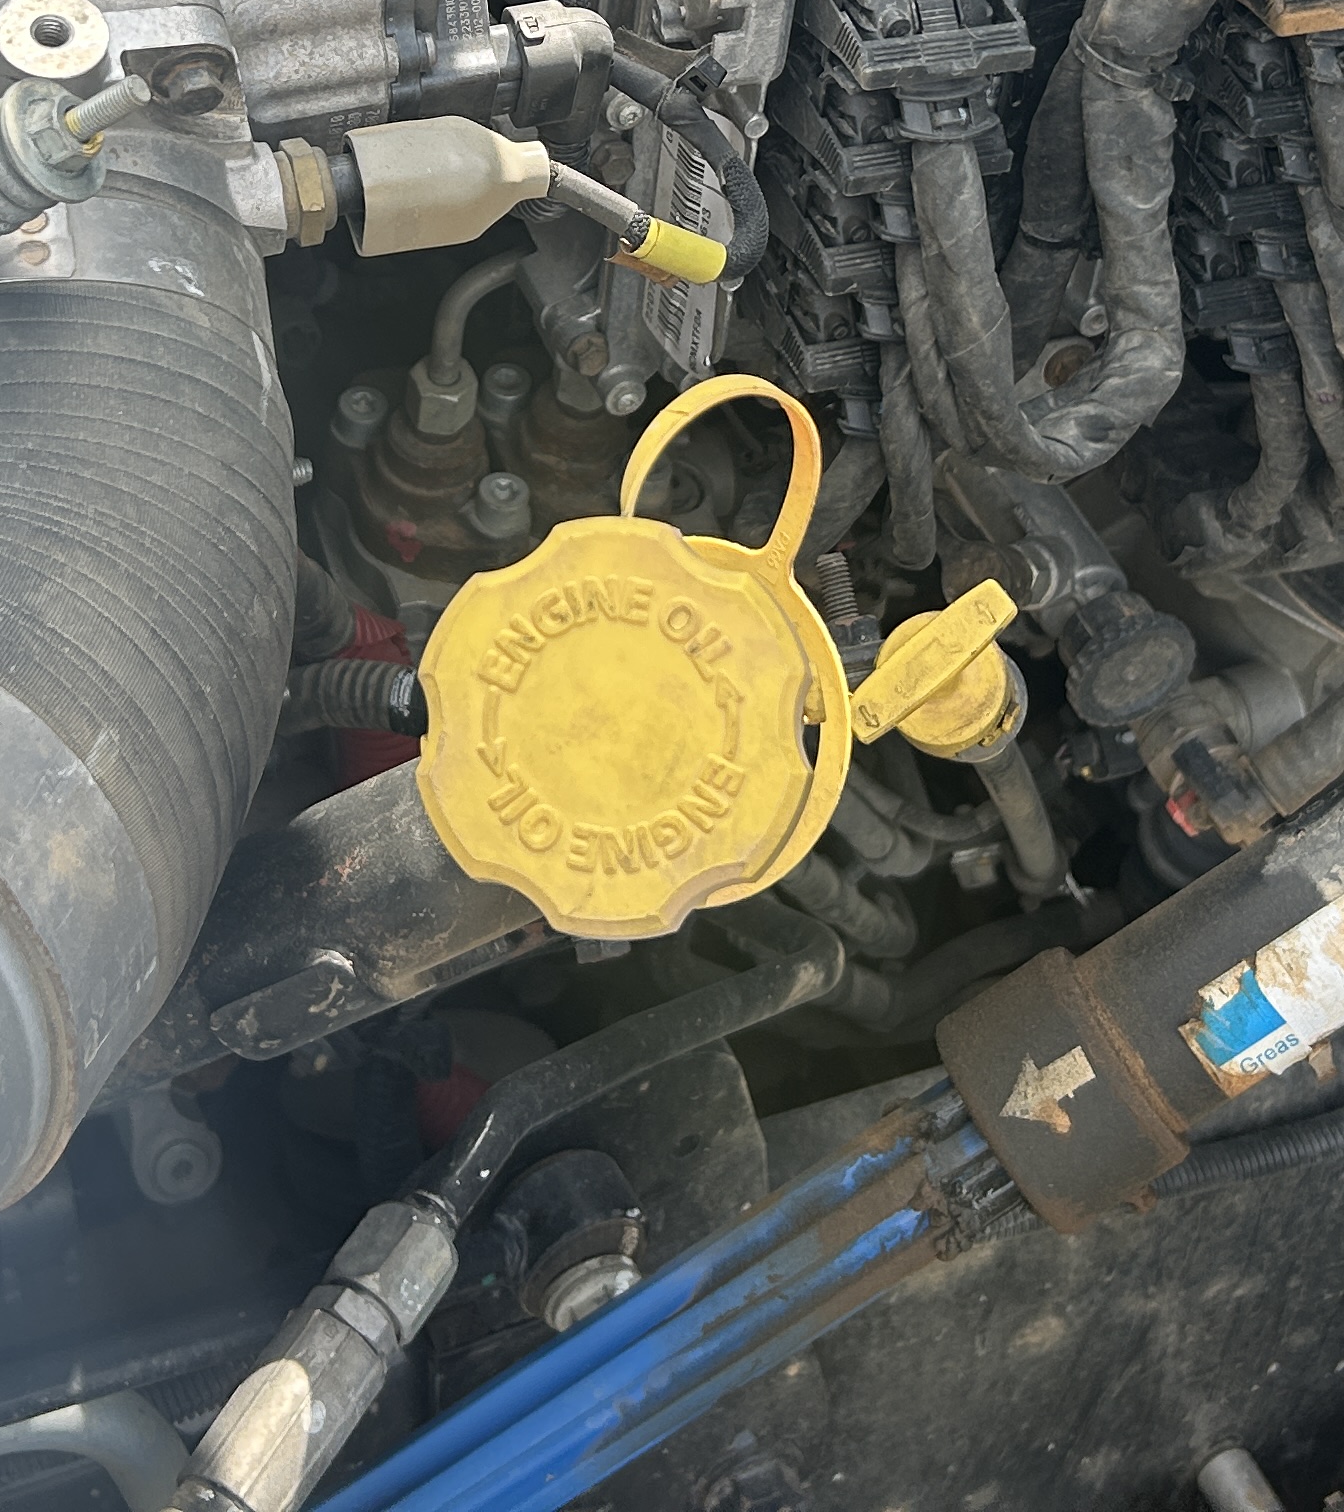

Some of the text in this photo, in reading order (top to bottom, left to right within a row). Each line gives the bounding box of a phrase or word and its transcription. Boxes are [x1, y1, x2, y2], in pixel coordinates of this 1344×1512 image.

[477, 574, 734, 694] ENGINE OIL
[487, 752, 746, 875] ENGINE OIL
